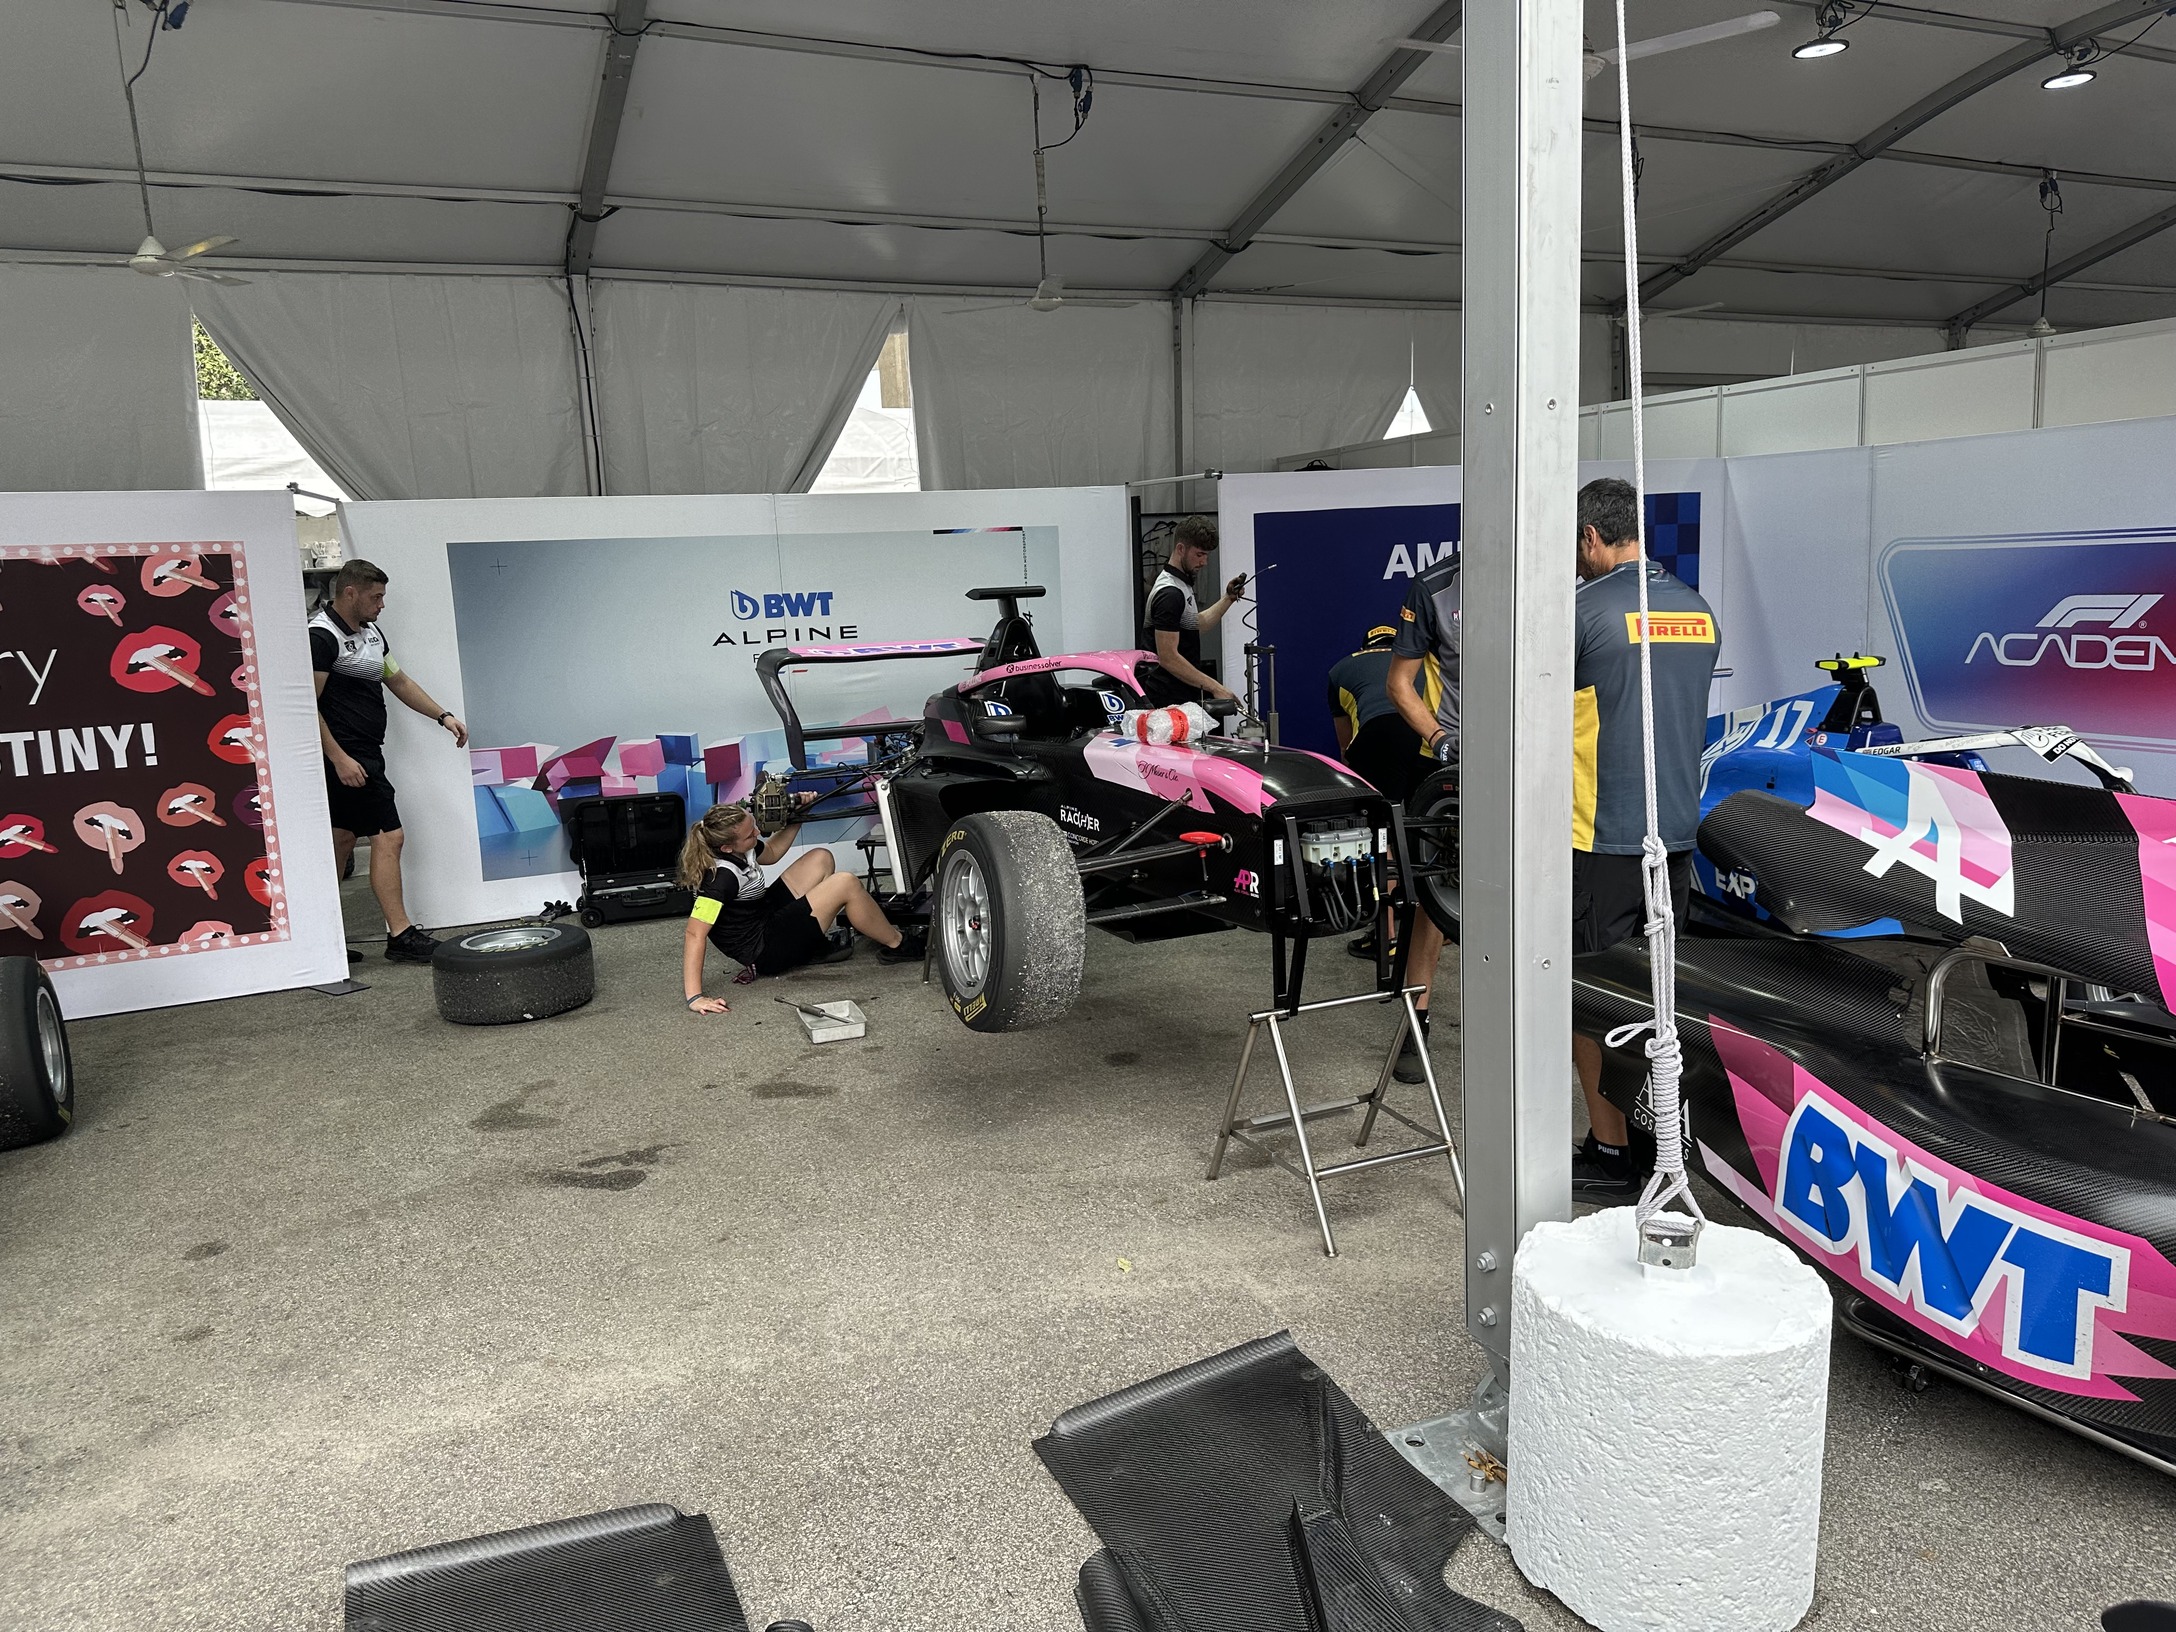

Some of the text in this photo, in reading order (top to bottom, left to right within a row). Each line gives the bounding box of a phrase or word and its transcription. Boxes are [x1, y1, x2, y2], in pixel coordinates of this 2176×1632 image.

[1383, 541, 1461, 580] AM
[763, 592, 834, 618] BWT
[2035, 594, 2165, 628] F1
[712, 625, 858, 647] ALPINE
[1635, 617, 1706, 637] PIRELLI
[1015, 660, 1062, 672] businessolver
[1754, 700, 1815, 750] 17
[0, 722, 158, 777] TINY!
[1872, 746, 1901, 756] EDGAR
[2053, 743, 2066, 755] DO
[1715, 866, 1756, 899] EXP
[1597, 1144, 1620, 1156] PUMA
[1782, 1105, 2113, 1367] BWT
